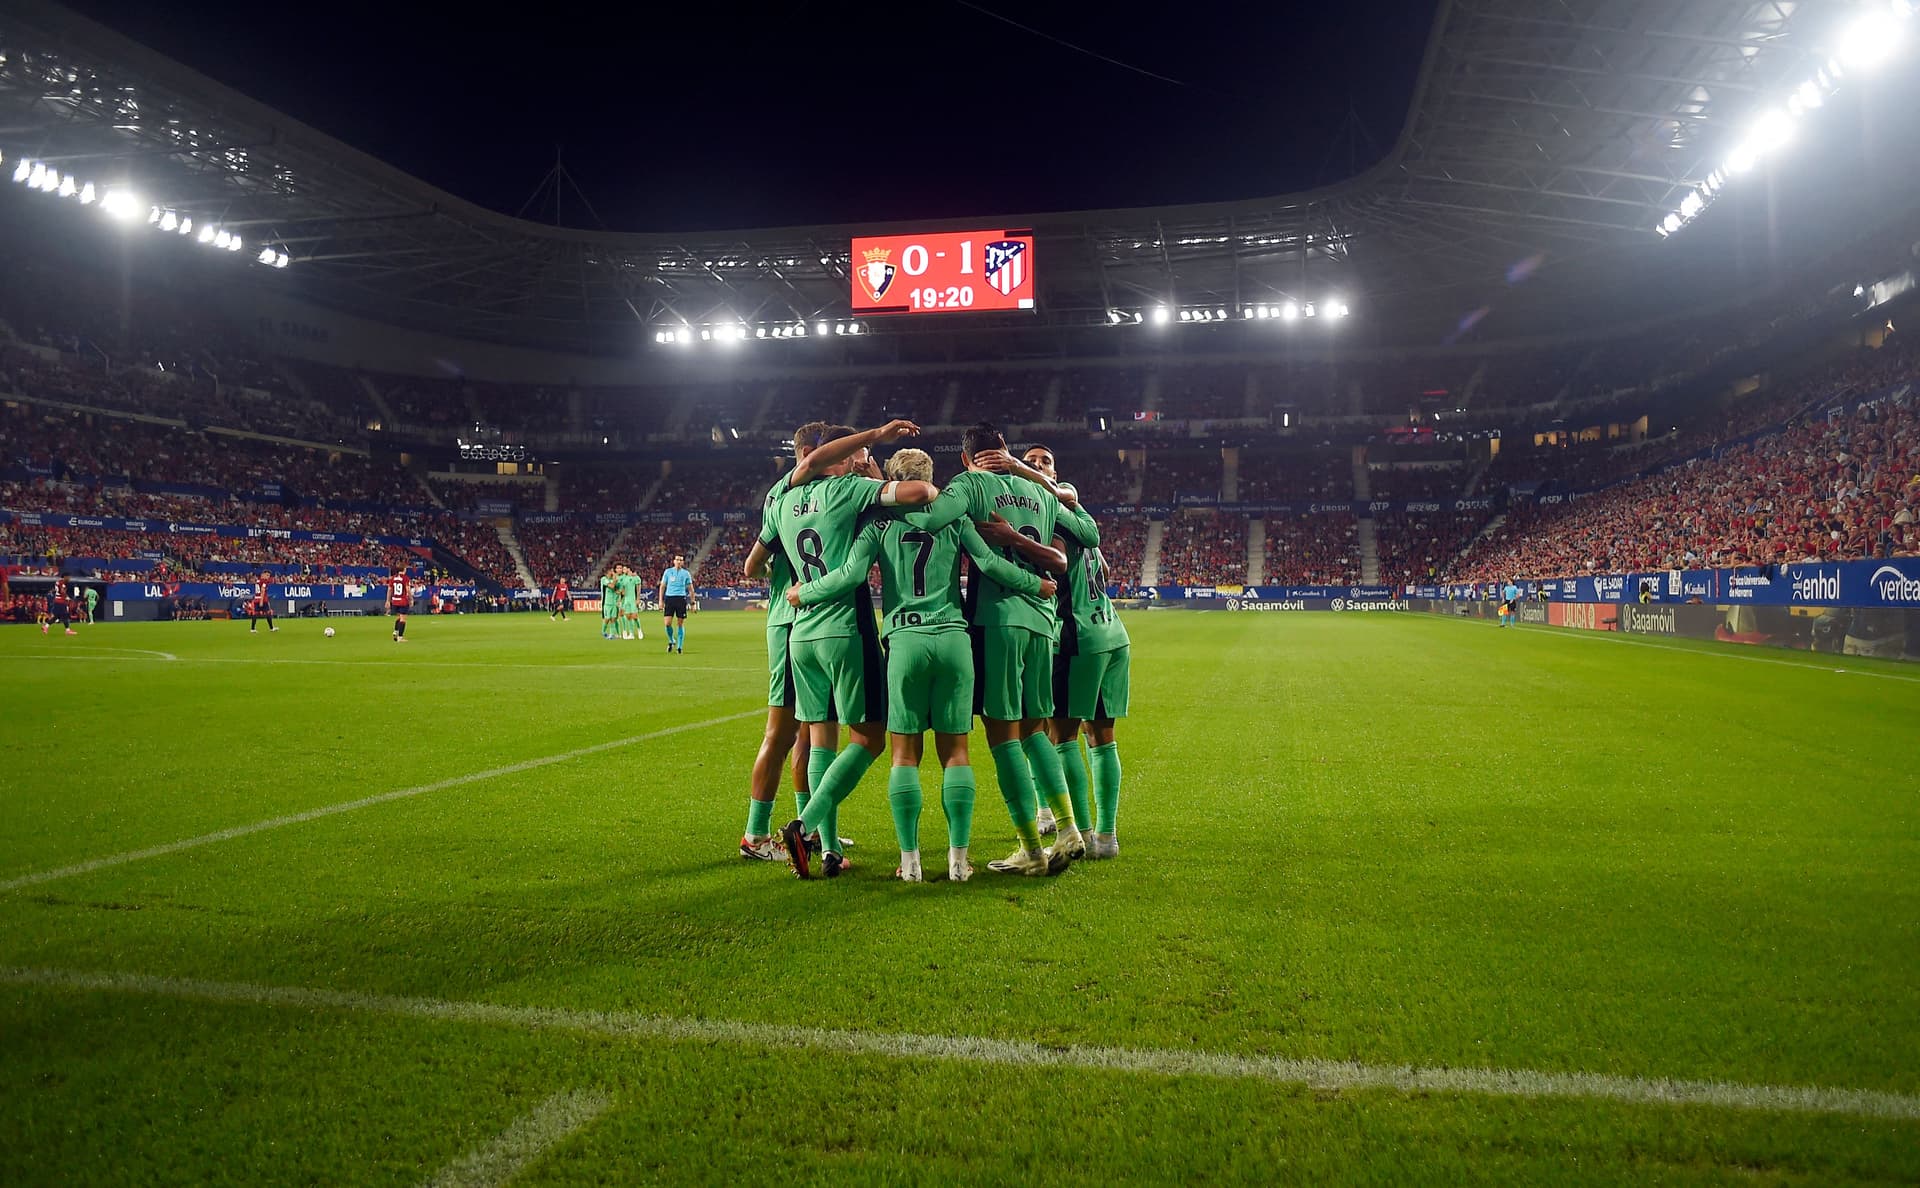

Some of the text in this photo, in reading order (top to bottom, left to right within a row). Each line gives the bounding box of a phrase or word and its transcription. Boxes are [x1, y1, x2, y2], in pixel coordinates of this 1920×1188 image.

[902, 245, 929, 276] 0
[960, 241, 974, 274] 1
[909, 286, 974, 309] 19:20
[1368, 501, 1389, 511] ATP
[797, 528, 828, 583] 8
[900, 530, 936, 599] 7
[285, 586, 312, 598] LALIGA
[393, 582, 403, 597] 19
[1803, 568, 1840, 600] enhol
[893, 607, 922, 628] ria
[1241, 600, 1305, 612] Sagamóvil
[1346, 600, 1409, 612] Sagamóvil
[1563, 603, 1586, 628] LALIGA
[1631, 607, 1676, 634] Sagamóvil
